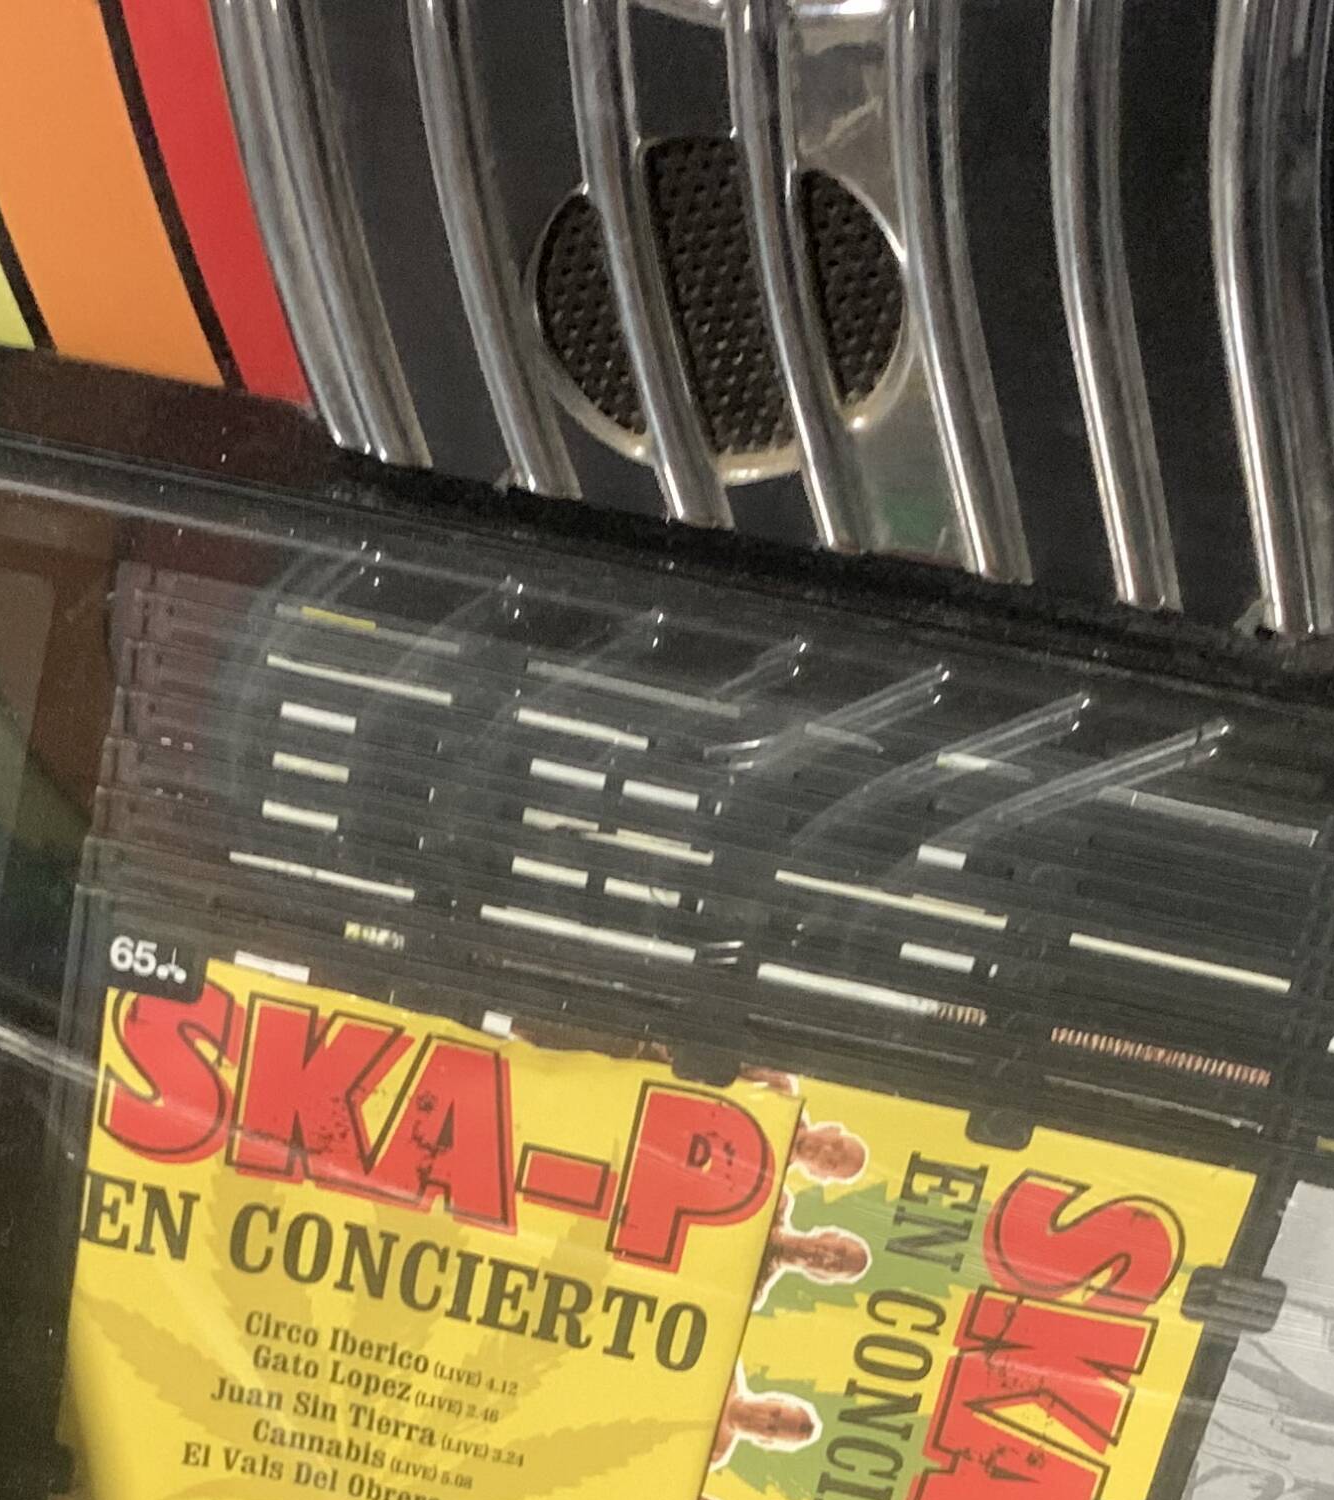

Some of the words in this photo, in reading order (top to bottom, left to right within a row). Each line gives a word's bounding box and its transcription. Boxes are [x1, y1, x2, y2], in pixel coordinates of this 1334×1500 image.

[98, 981, 775, 1274] SKA-P
[882, 1150, 990, 1273] EN
[80, 1173, 200, 1261] EN
[229, 1202, 707, 1373] CONCIERTO
[246, 1310, 318, 1347] Circo
[329, 1325, 429, 1375] Iberico
[433, 1359, 481, 1388] (LIVE)
[253, 1344, 319, 1380] Gato
[329, 1359, 411, 1401] Lopez
[415, 1389, 463, 1418] (LIVE)
[211, 1377, 283, 1412] Juan
[292, 1390, 337, 1423] Sin
[349, 1400, 436, 1448] Tierra
[440, 1432, 489, 1461] (LIVE)
[253, 1419, 385, 1470] Cannabis
[389, 1456, 437, 1485] (LIVE)
[181, 1441, 210, 1469] El
[223, 1447, 284, 1481] Vals
[294, 1461, 337, 1492] Del
